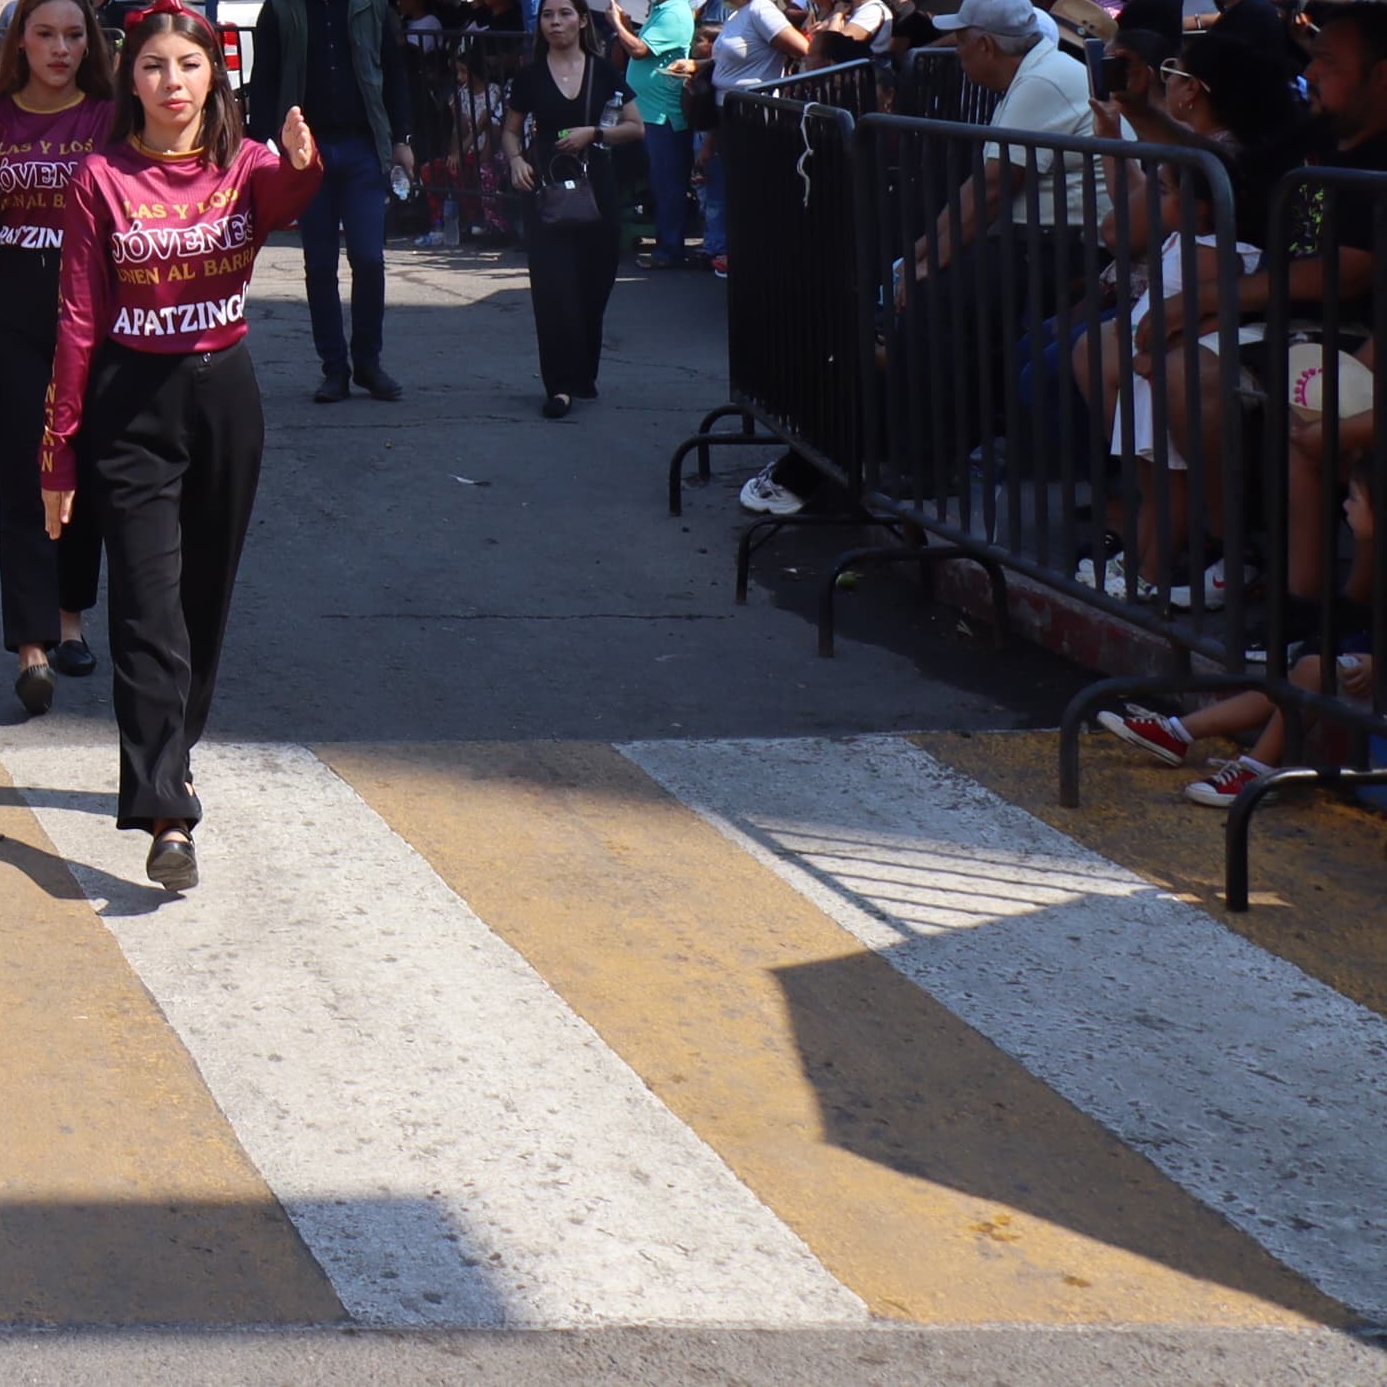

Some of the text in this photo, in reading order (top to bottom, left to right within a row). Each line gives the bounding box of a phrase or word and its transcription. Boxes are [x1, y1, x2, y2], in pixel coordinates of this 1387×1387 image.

[39, 140, 52, 155] Y
[59, 138, 94, 155] LOS
[123, 188, 239, 220] LAS Y LOS
[167, 262, 196, 282] AL
